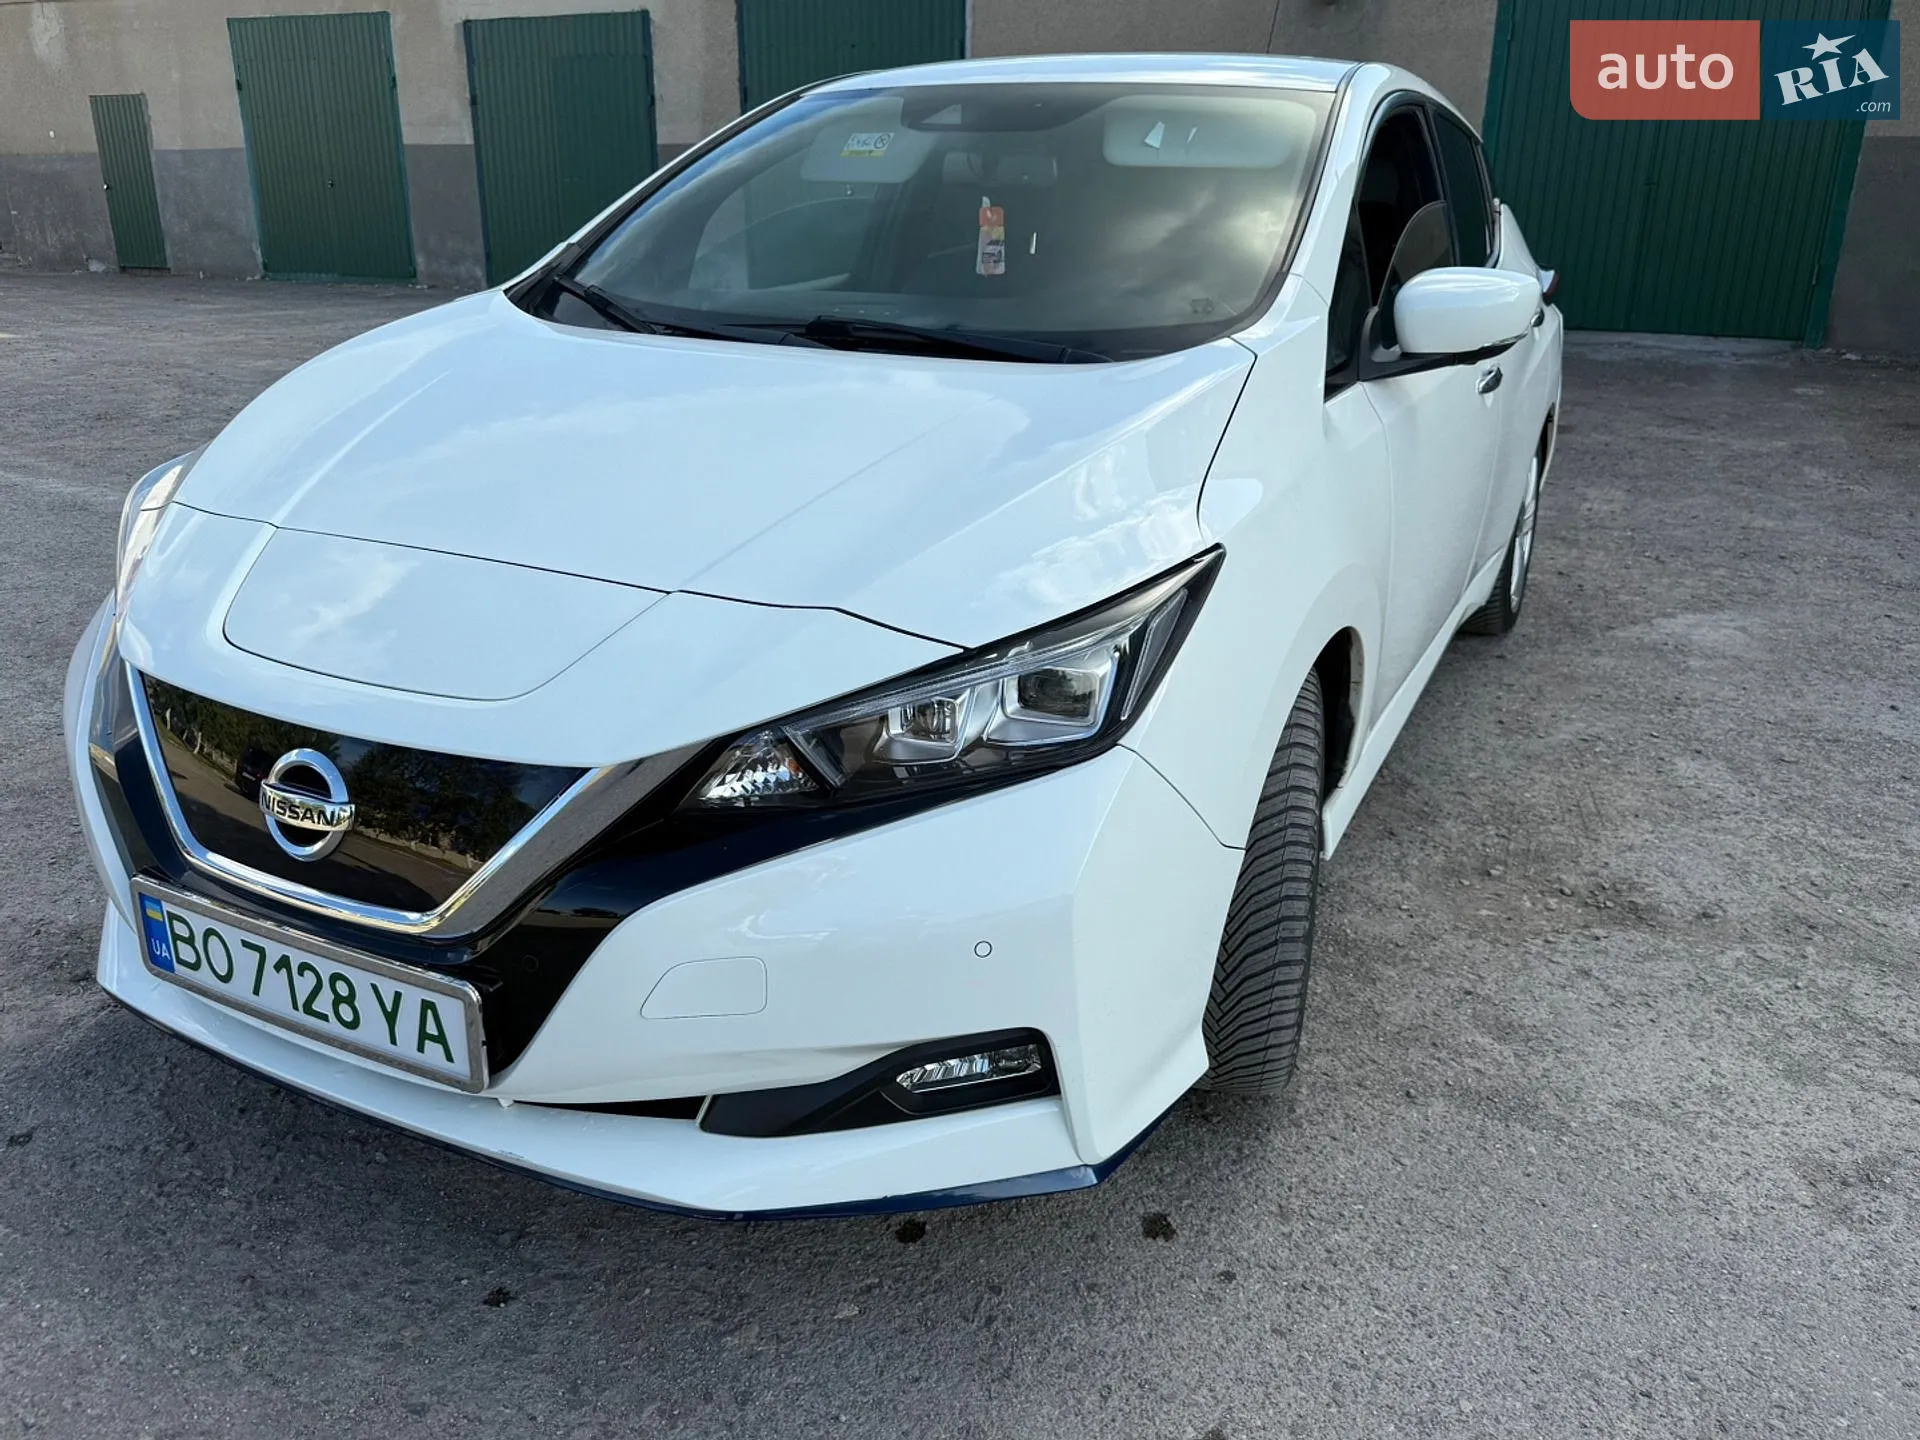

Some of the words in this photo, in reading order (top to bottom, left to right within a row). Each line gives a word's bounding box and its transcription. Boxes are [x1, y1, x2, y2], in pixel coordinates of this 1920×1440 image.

[261, 791, 336, 828] NISSAN
[151, 938, 171, 962] UA
[166, 909, 235, 984] BO
[241, 938, 362, 1031] 7128
[370, 982, 455, 1064] YA
